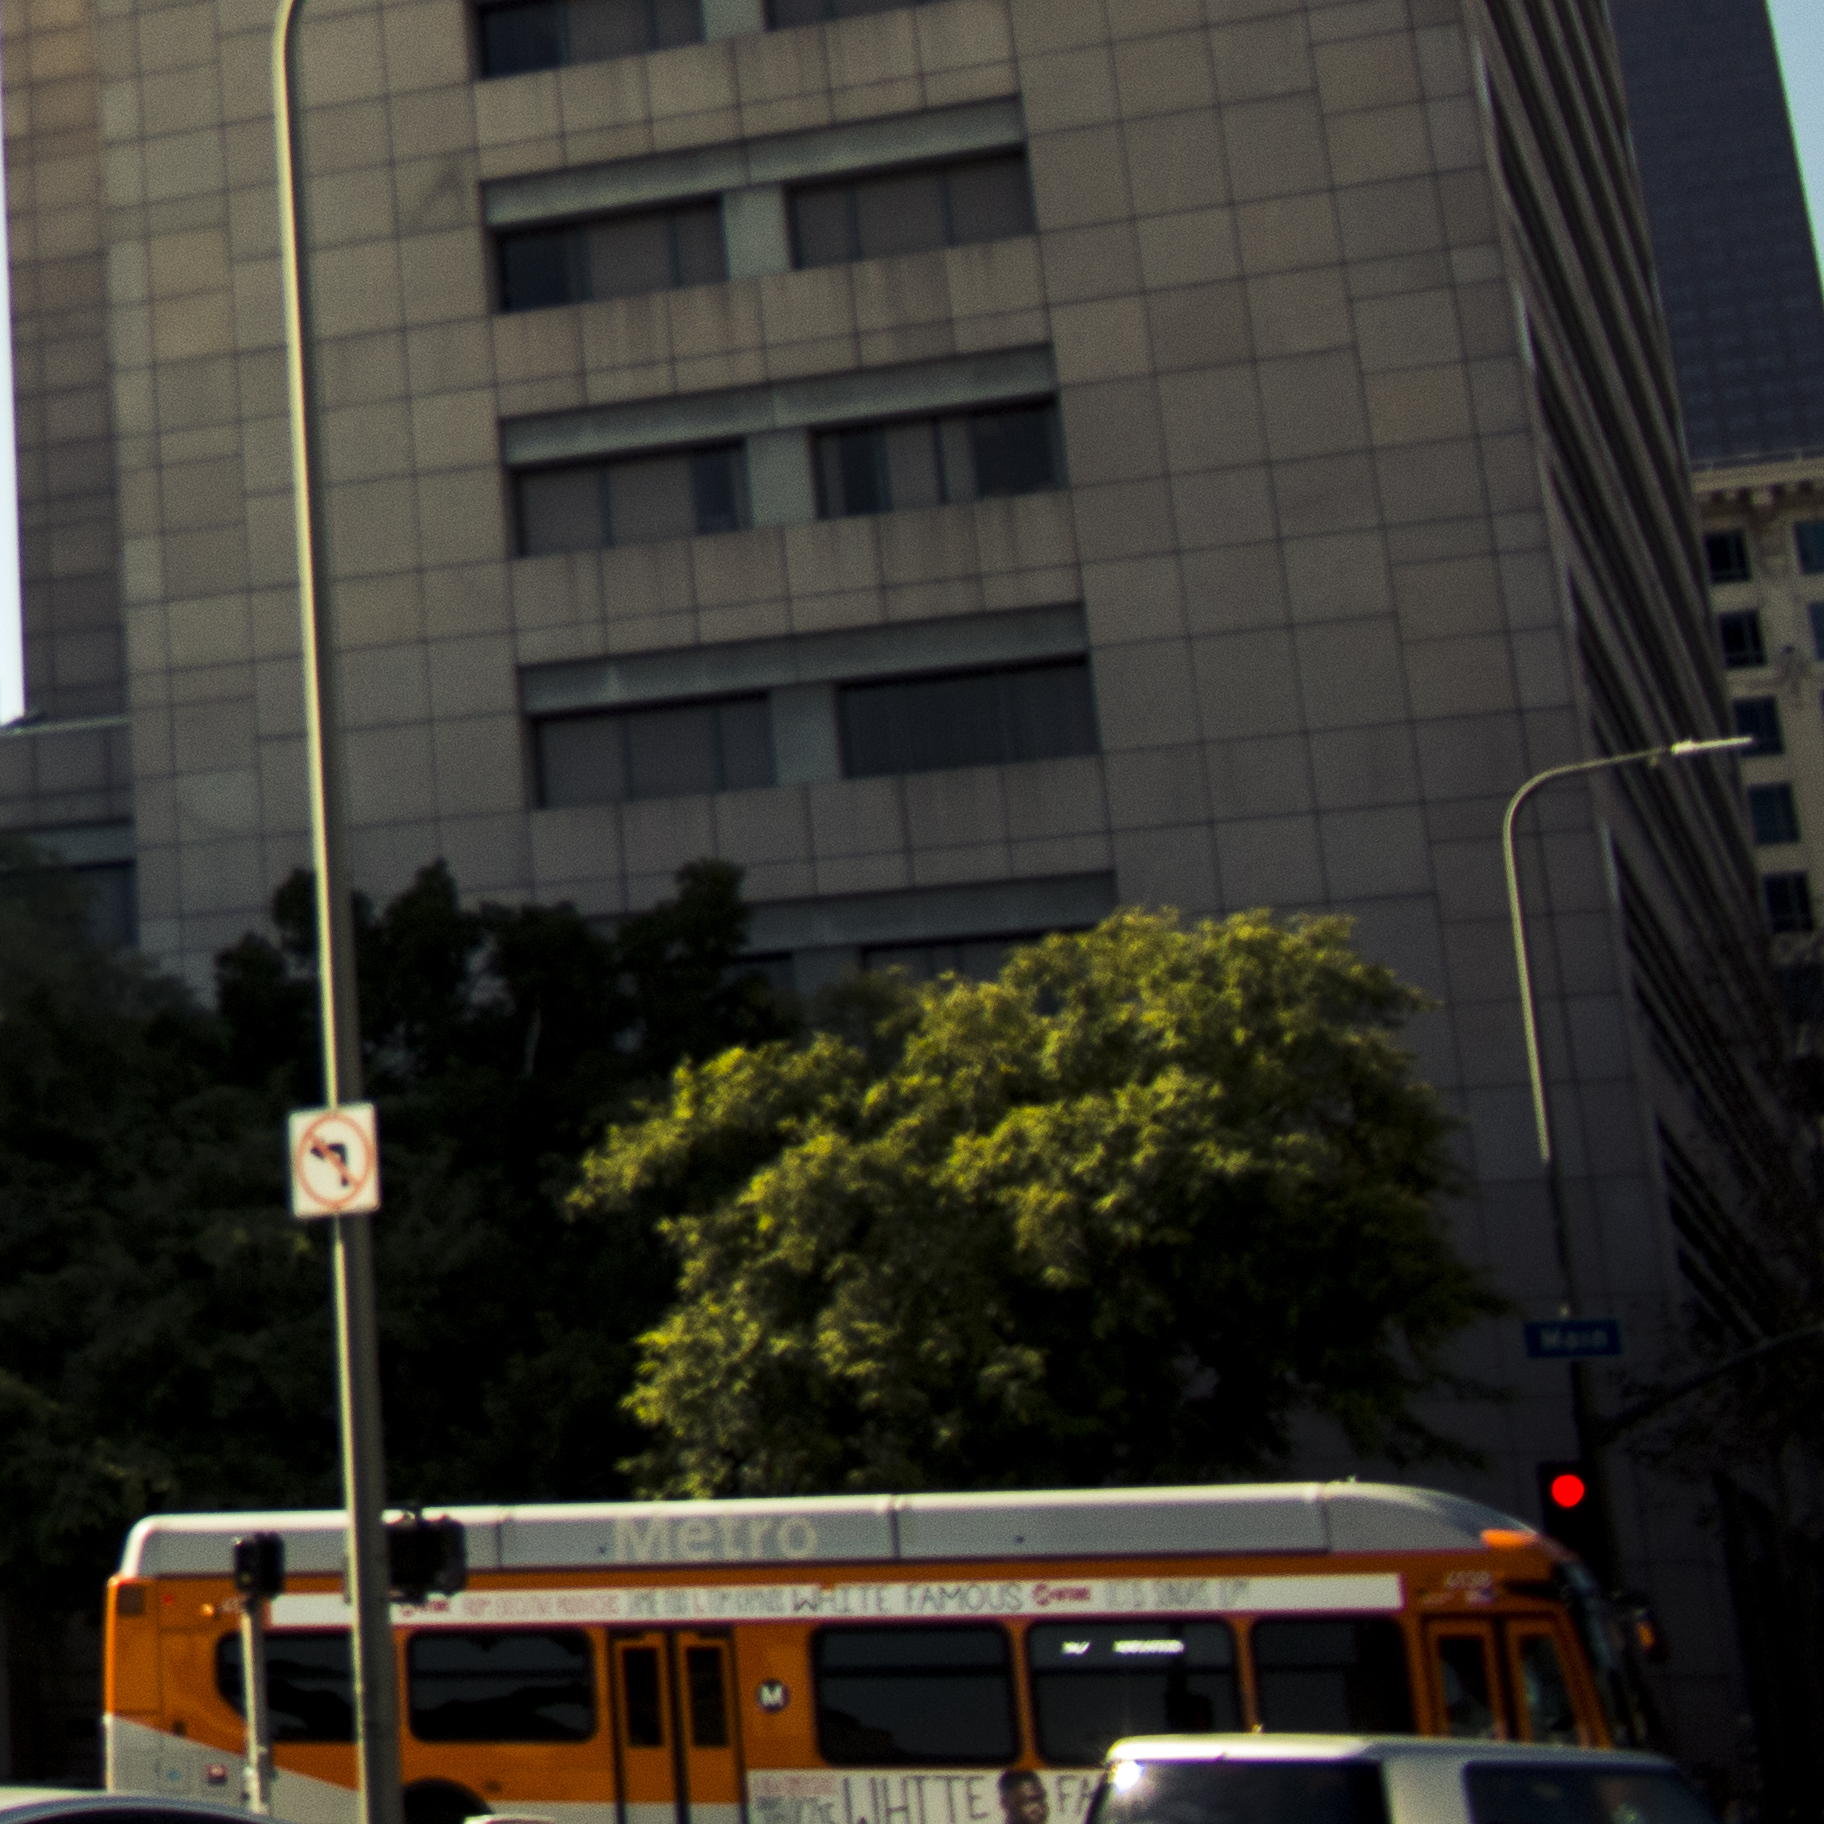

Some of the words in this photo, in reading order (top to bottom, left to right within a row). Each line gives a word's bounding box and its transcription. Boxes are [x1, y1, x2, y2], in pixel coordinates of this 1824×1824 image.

[612, 1514, 819, 1562] Metro
[791, 1583, 890, 1615] WHITE
[903, 1581, 1023, 1613] FAMOUS
[842, 1775, 990, 1824] WHITE
